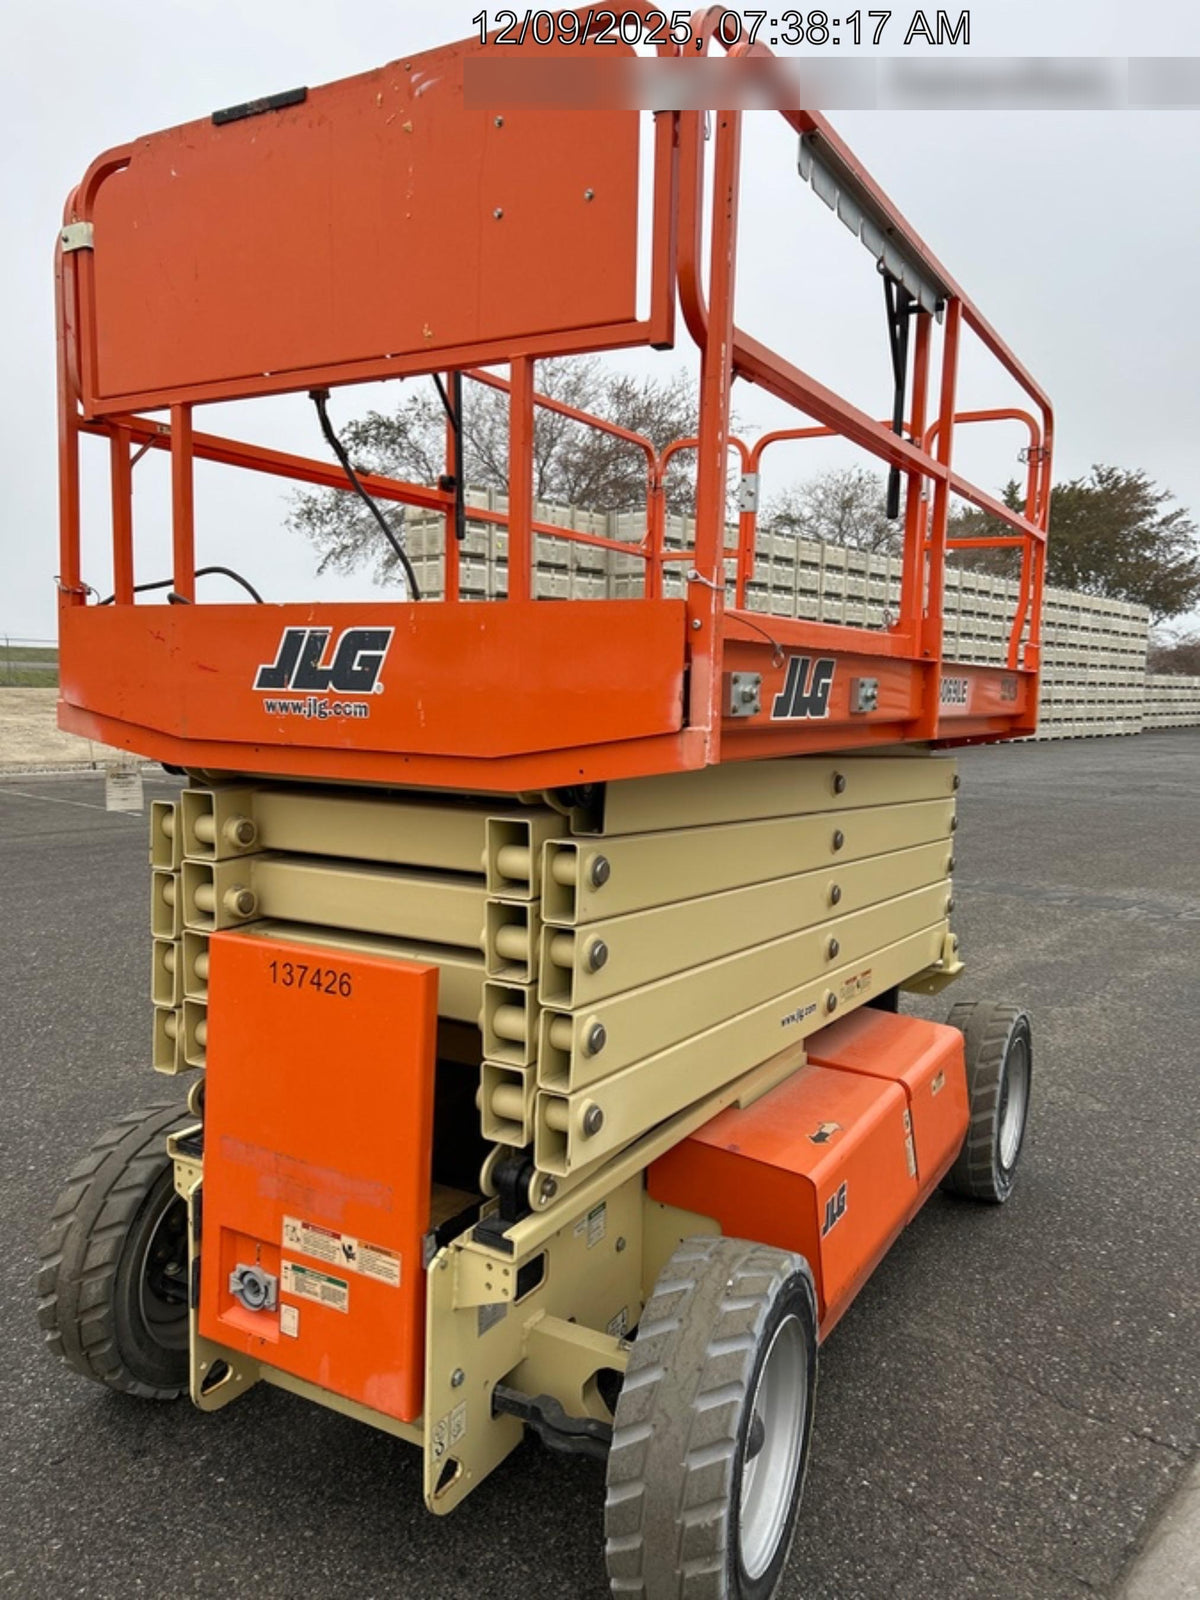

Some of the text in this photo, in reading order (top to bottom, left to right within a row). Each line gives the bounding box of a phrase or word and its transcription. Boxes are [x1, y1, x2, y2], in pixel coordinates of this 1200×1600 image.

[253, 627, 395, 694] JLG
[770, 656, 837, 720] JLG
[264, 698, 369, 719] www.jlg.com
[269, 961, 352, 997] 137426
[822, 1181, 847, 1237] JLG
